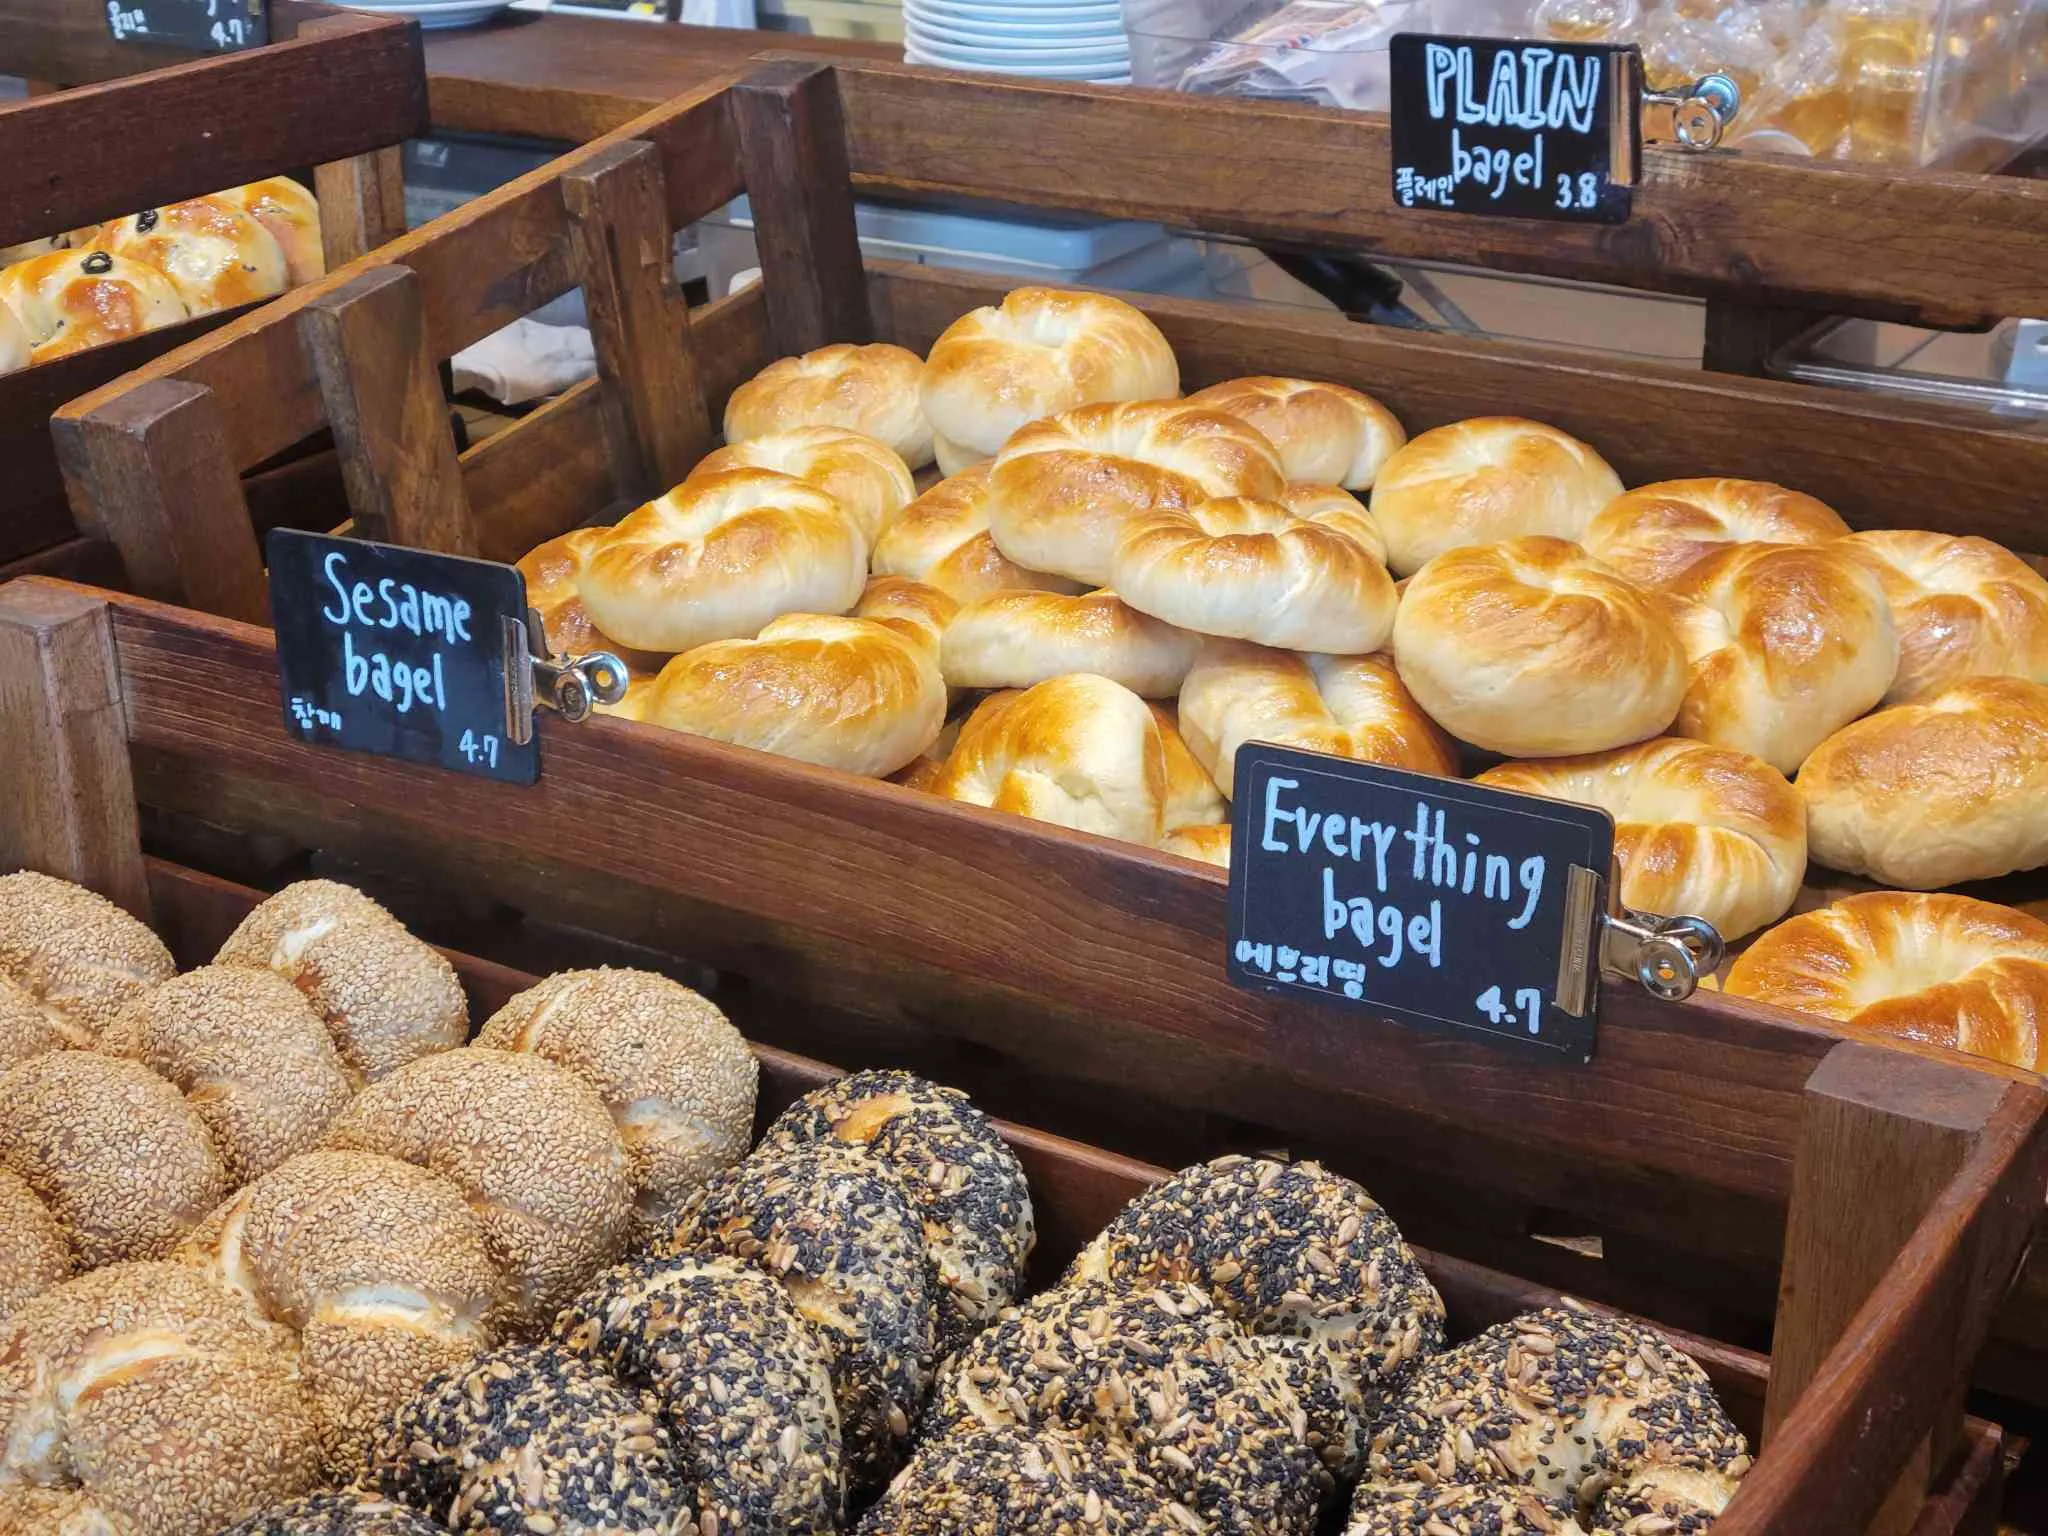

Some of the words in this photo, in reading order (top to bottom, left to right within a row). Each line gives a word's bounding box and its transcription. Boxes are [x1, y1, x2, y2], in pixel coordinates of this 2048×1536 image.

[210, 19, 244, 47] 4.7
[1425, 43, 1600, 133] PLAIN
[1396, 167, 1454, 207] 플레인
[1452, 128, 1543, 199] bagel
[1555, 173, 1598, 208] 3.8
[323, 552, 472, 644] Sesame
[344, 632, 445, 712] bagel
[458, 729, 499, 768] 4.7
[1261, 777, 1546, 930] Everything
[1322, 867, 1442, 968] bagel
[1475, 984, 1542, 1034] 4.7
